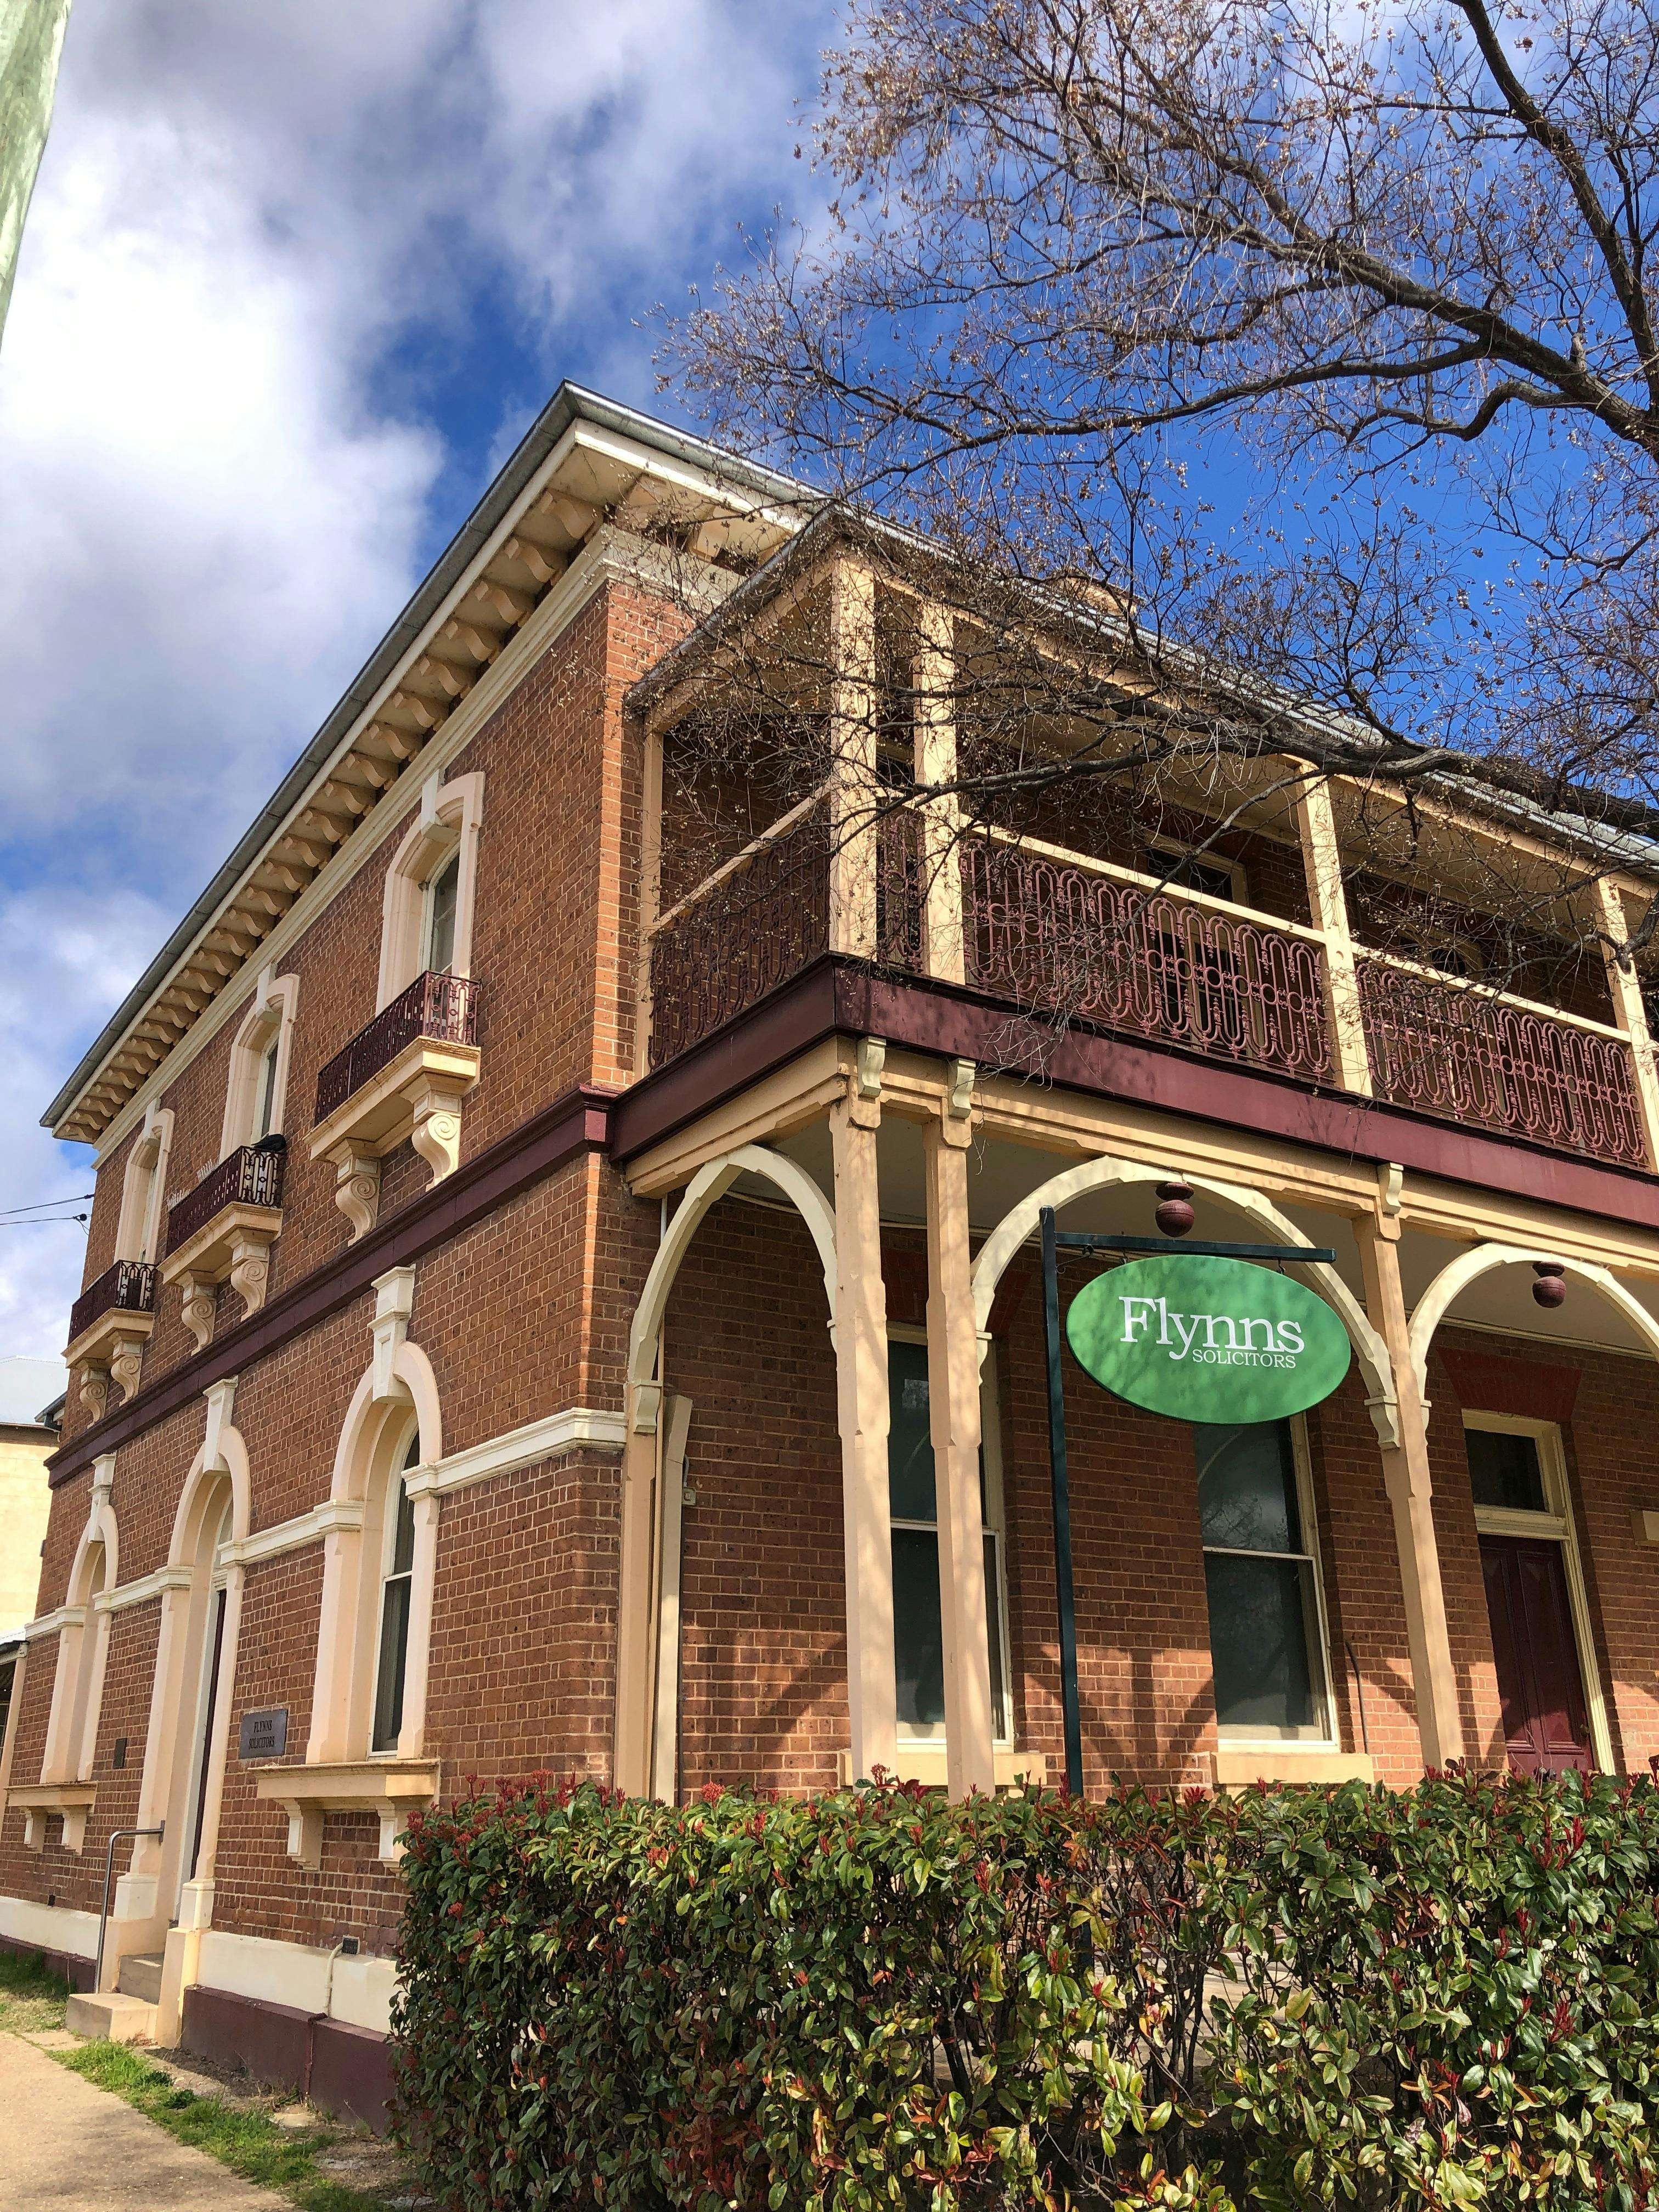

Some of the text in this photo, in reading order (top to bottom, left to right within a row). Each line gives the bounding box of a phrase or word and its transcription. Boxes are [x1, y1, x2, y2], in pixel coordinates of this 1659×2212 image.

[1119, 1296, 1305, 1360] Flynns
[1192, 1349, 1296, 1369] SOLICITORS
[253, 1720, 273, 1733] FLYNNS
[249, 1736, 275, 1750] SOLICITORS
